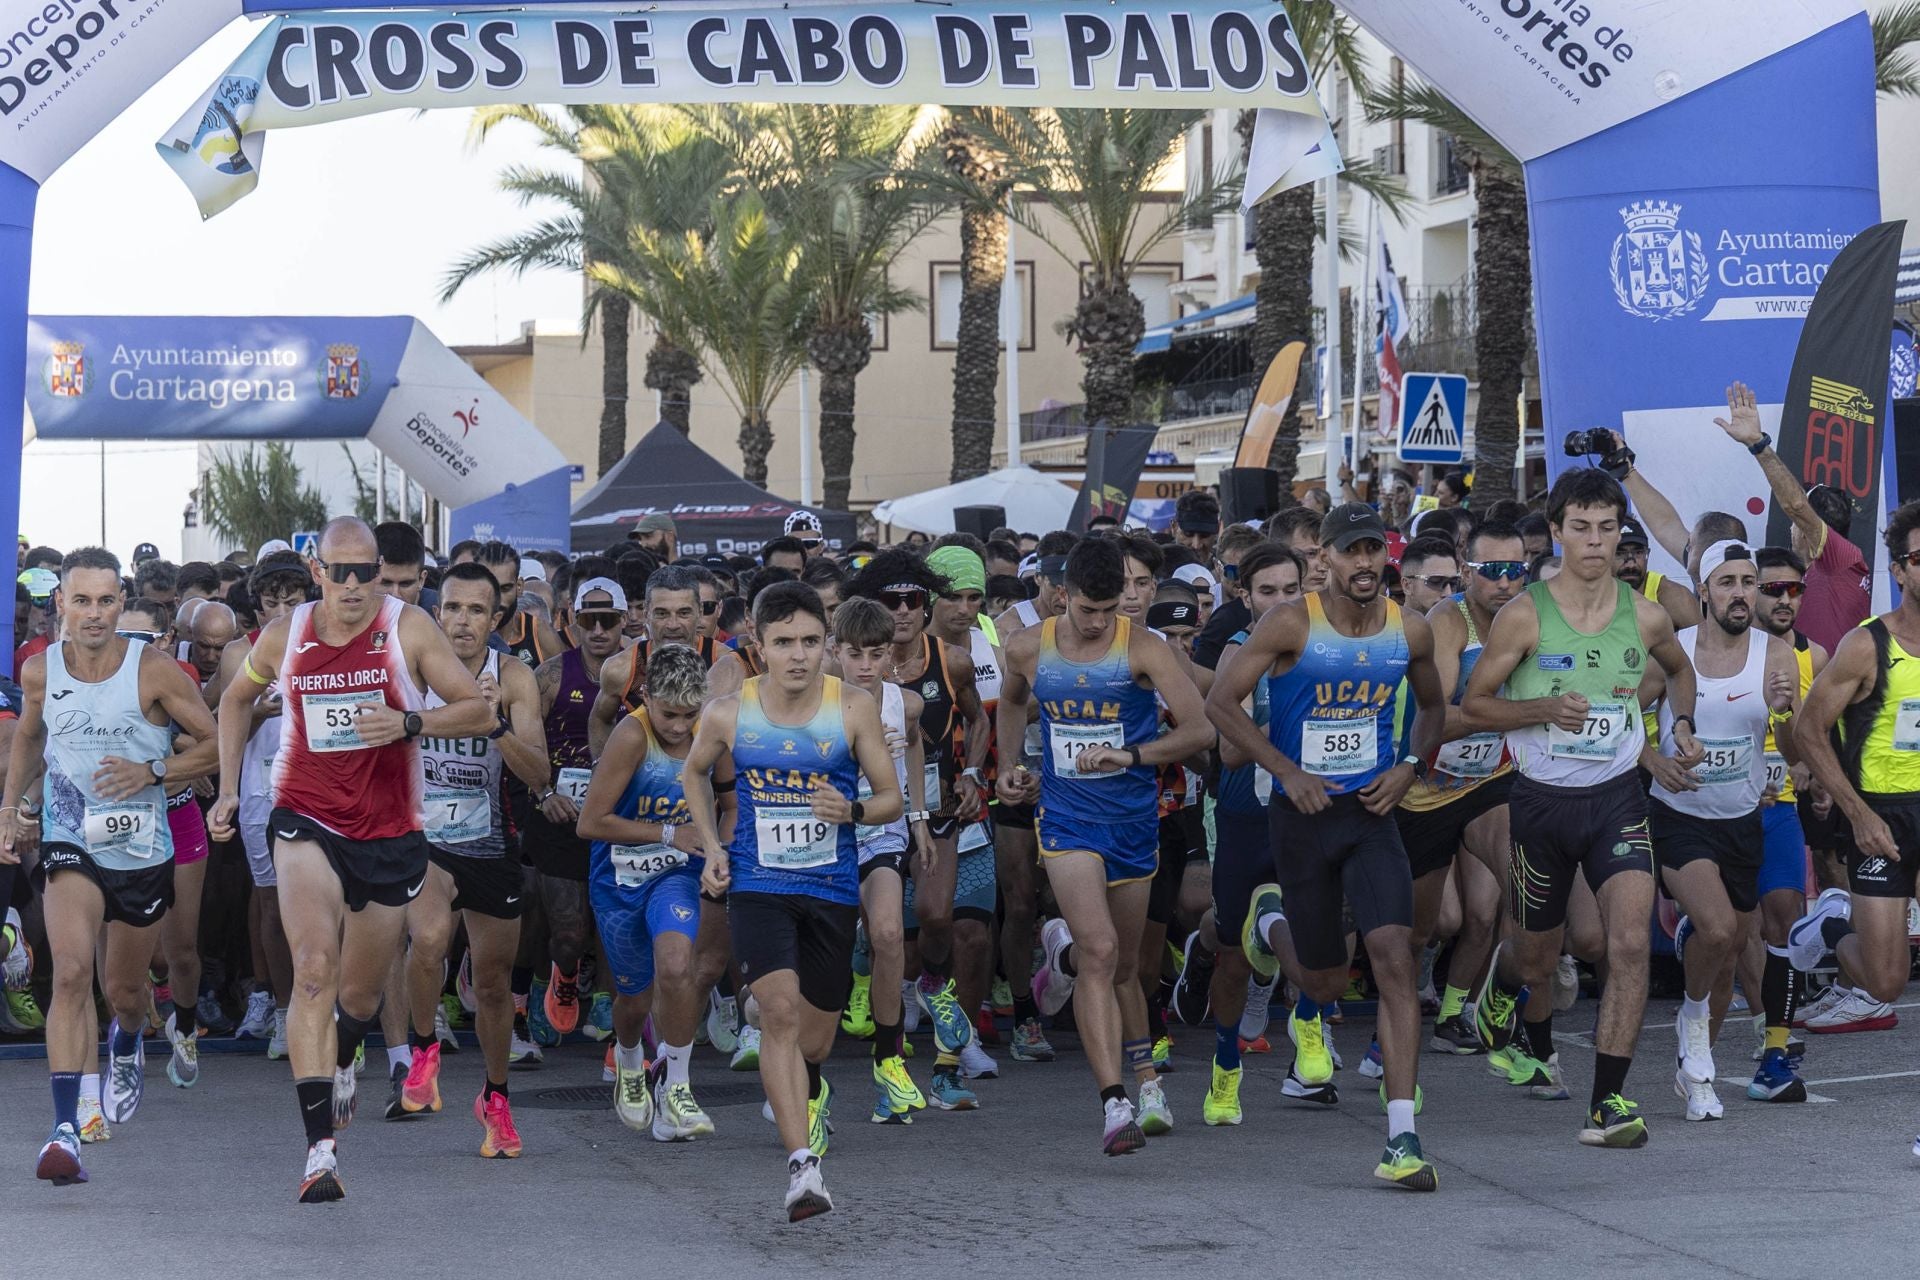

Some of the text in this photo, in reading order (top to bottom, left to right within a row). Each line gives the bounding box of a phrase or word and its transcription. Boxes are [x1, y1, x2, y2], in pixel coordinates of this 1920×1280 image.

[1594, 26, 1634, 63] de
[0, 0, 138, 116] Depor
[16, 0, 167, 132] AYUNTAMIENTO DE CART
[265, 12, 1310, 109] CROSS DE CABO DE PALOS
[1494, 26, 1511, 42] DE
[1513, 44, 1581, 106] CARTAGENA
[110, 344, 298, 370] Ayuntamiento
[109, 370, 297, 409] Cartagena
[1817, 400, 1867, 422] 1925 2025
[406, 417, 471, 478] Deportes
[416, 411, 464, 456] Concejalía
[464, 451, 479, 469] de
[291, 668, 389, 691] PUERTAS LORCA
[1315, 680, 1394, 707] UCAM
[1043, 699, 1121, 721] UCAM
[331, 729, 356, 737] ALBER
[1323, 733, 1361, 752] 583
[1458, 743, 1493, 760] 217
[1702, 749, 1736, 767] 451
[745, 767, 829, 790] UCAM
[446, 802, 459, 821] 7
[638, 795, 689, 816] UCA
[105, 814, 140, 834] 991
[771, 822, 828, 843] 1119
[786, 845, 812, 853] VICTOR
[626, 855, 677, 874] 1439
